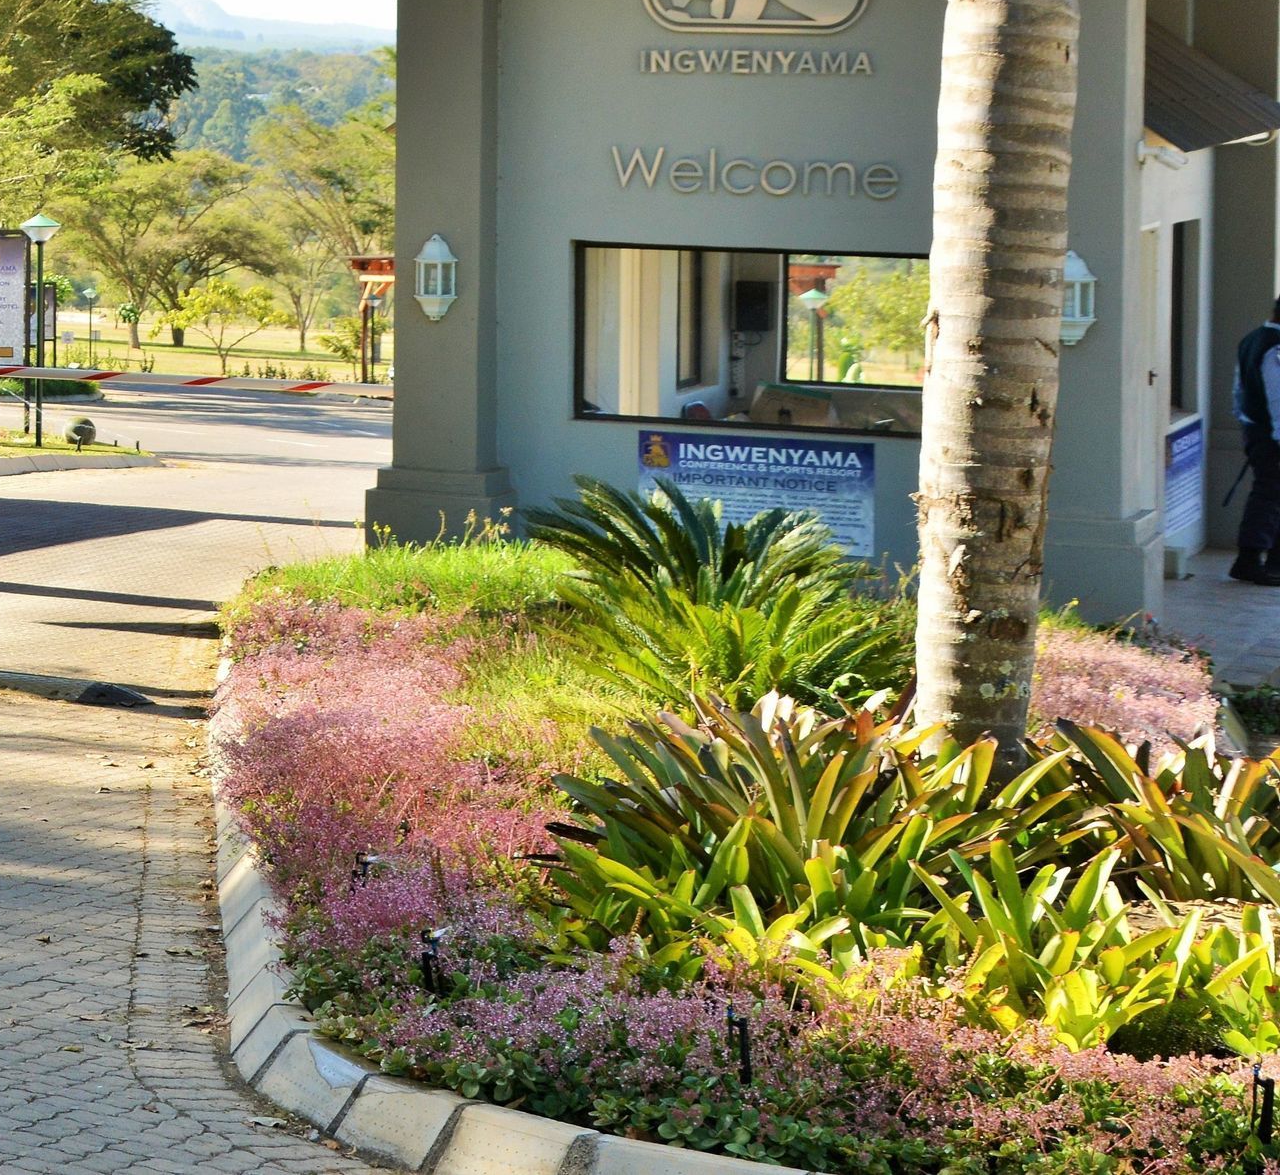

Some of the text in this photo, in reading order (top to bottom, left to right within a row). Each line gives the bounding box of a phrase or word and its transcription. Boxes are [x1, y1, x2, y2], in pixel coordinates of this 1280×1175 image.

[641, 49, 873, 76] INGWENYAMA
[611, 145, 899, 199] Welcome
[678, 442, 862, 469] INGWENYAMA
[678, 460, 862, 478] CONFERENCE & SPORTS RESORT
[672, 472, 837, 492] IMPORTANT NOTICE
